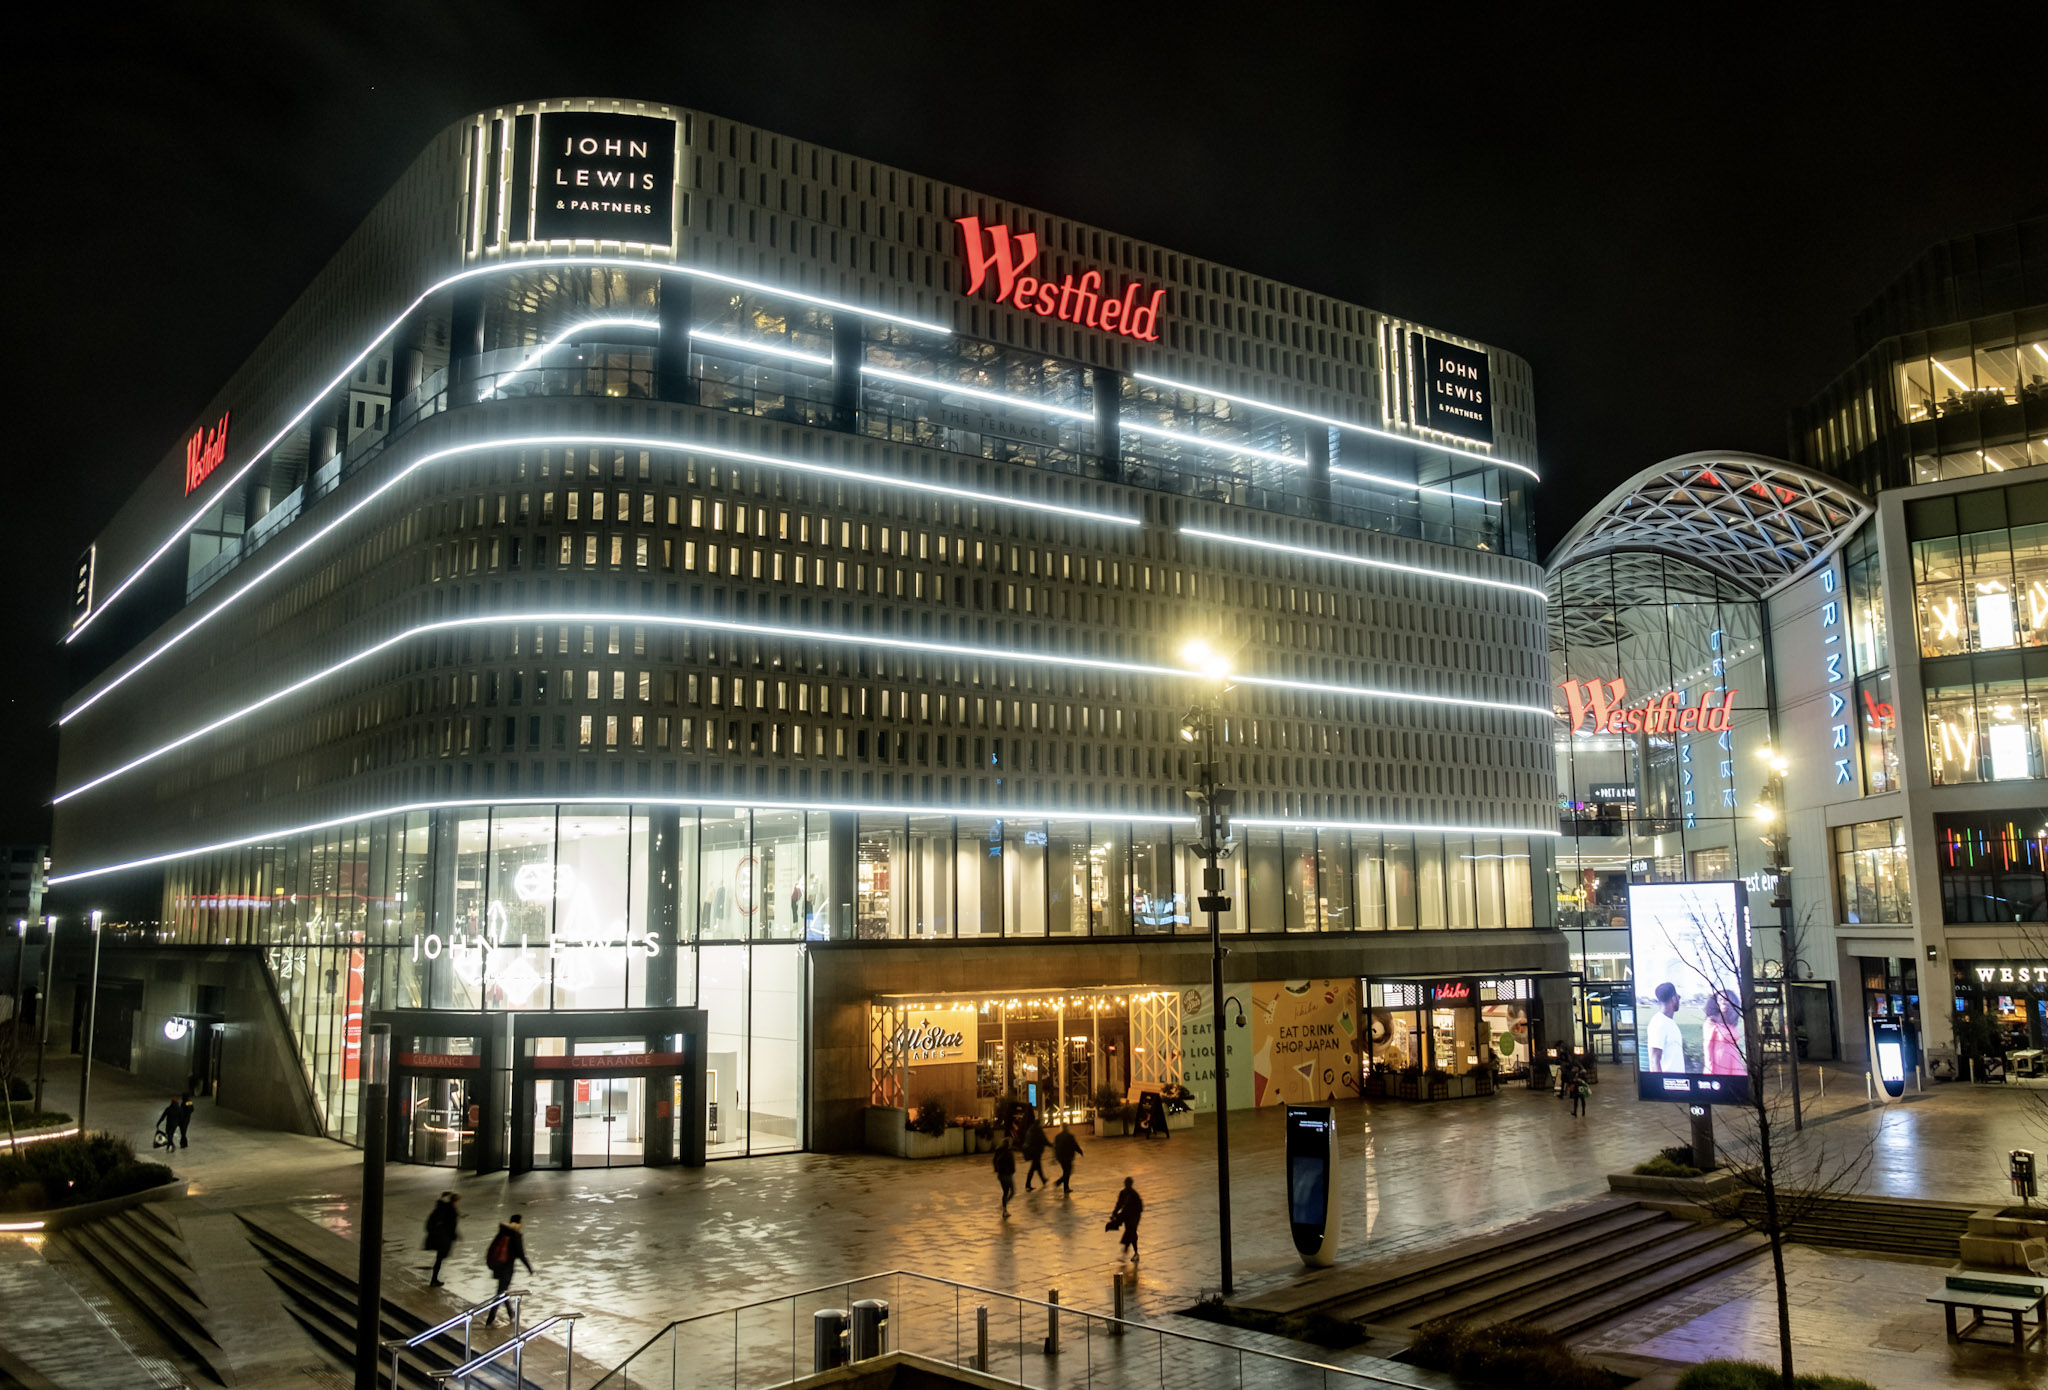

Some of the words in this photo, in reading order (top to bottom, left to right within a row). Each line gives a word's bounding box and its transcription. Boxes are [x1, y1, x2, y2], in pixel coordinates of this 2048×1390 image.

[564, 137, 648, 159] JOHN
[556, 168, 654, 191] LEWIS
[556, 200, 565, 210] &
[571, 200, 652, 214] PARTNERS
[955, 216, 1166, 342] Westfield
[1439, 358, 1478, 381] JOHN
[1436, 380, 1483, 404] LEWIS
[1439, 403, 1445, 411] &
[1445, 404, 1483, 421] PARTNERS
[184, 410, 230, 497] Westfield
[1820, 569, 1851, 785] PRIMARK
[1558, 677, 1739, 735] Westfield
[1679, 690, 1696, 829] PIMARK
[412, 933, 499, 963] JOHN
[521, 931, 660, 959] LEWIS
[1975, 967, 2048, 983] WEST
[1280, 1026, 1299, 1039] EAT
[1302, 1024, 1334, 1037] DRINK
[912, 1050, 946, 1060] ANES
[1191, 1045, 1233, 1058] LIQUR
[1276, 1040, 1303, 1054] SHOP
[1305, 1038, 1340, 1052] JAPAN
[413, 1055, 465, 1066] CLEARANCE
[571, 1055, 652, 1067] CLEARANCE
[1195, 1069, 1230, 1081] LANS
